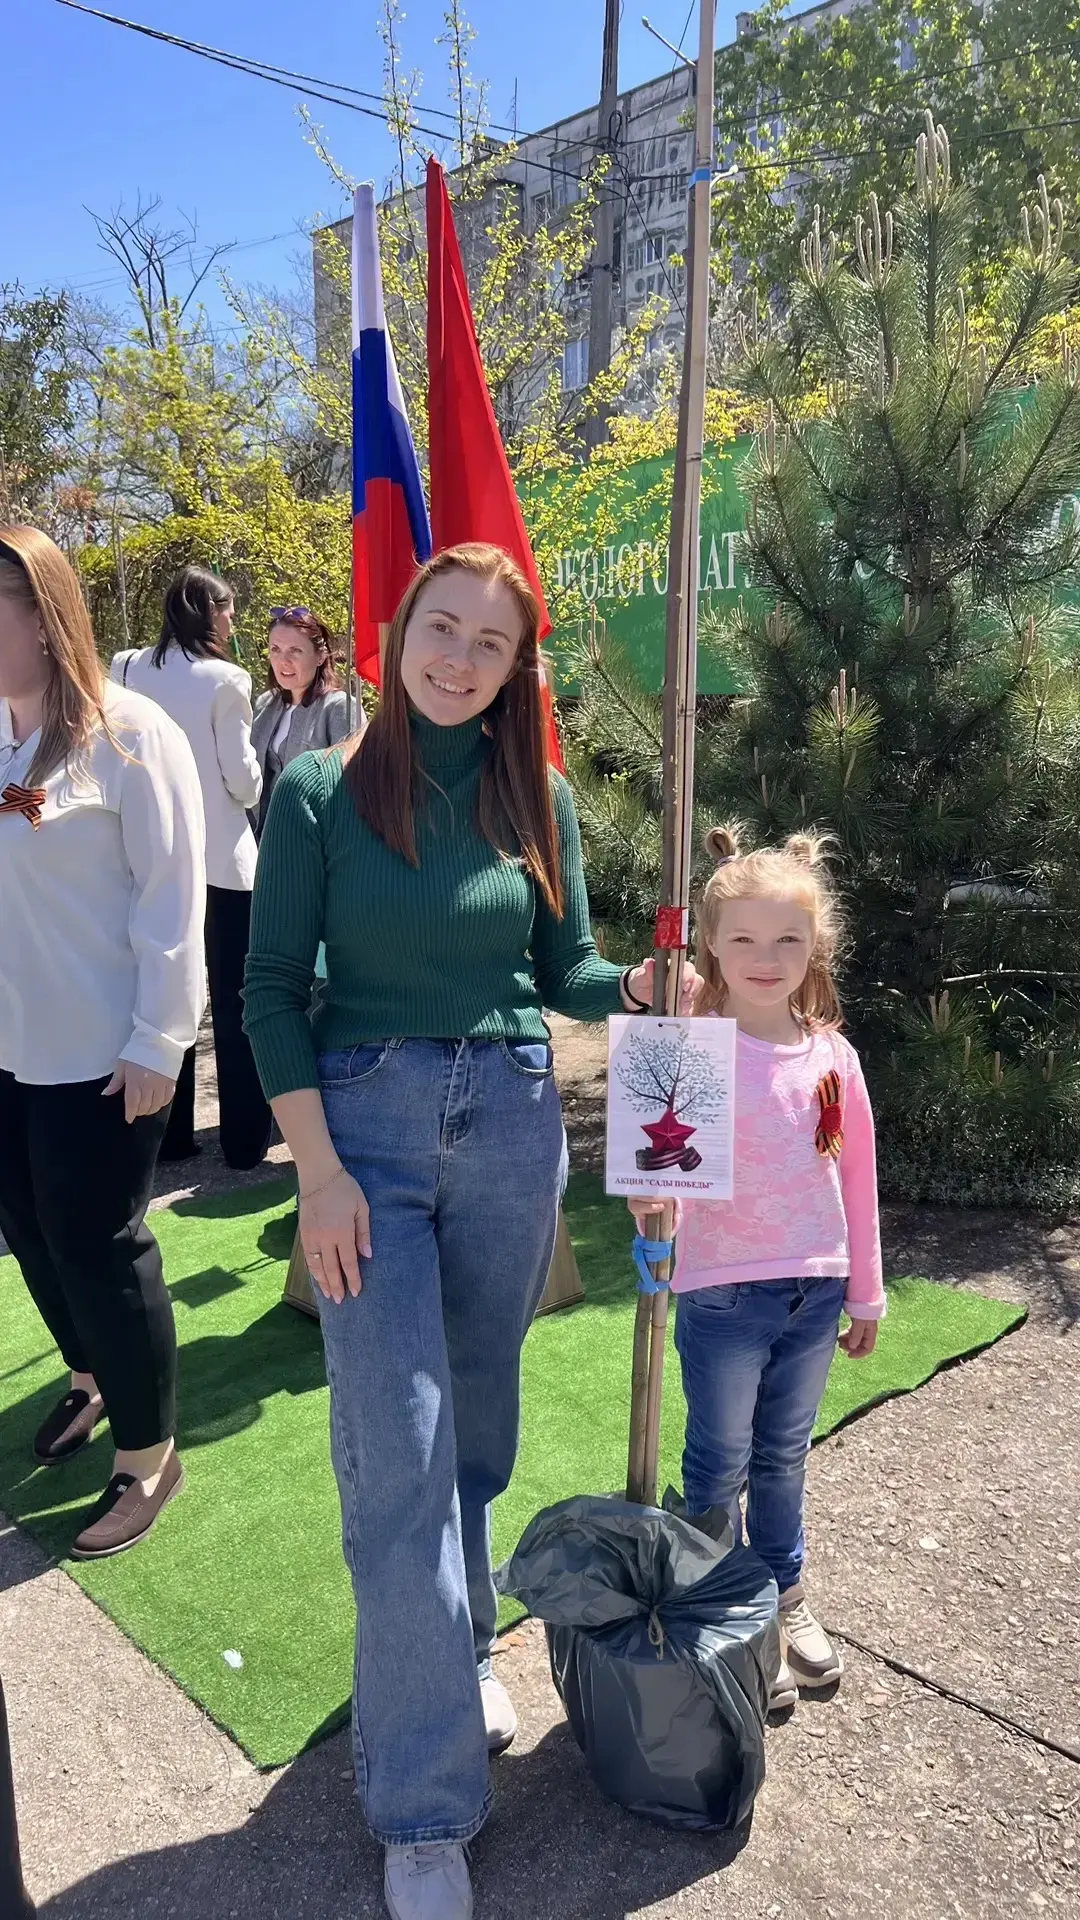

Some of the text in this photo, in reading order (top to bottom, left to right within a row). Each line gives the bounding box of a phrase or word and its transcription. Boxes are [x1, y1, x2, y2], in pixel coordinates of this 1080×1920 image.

[614, 1177, 714, 1189] АКЦИЯ "САДЫ ПОБЕДЫ"
